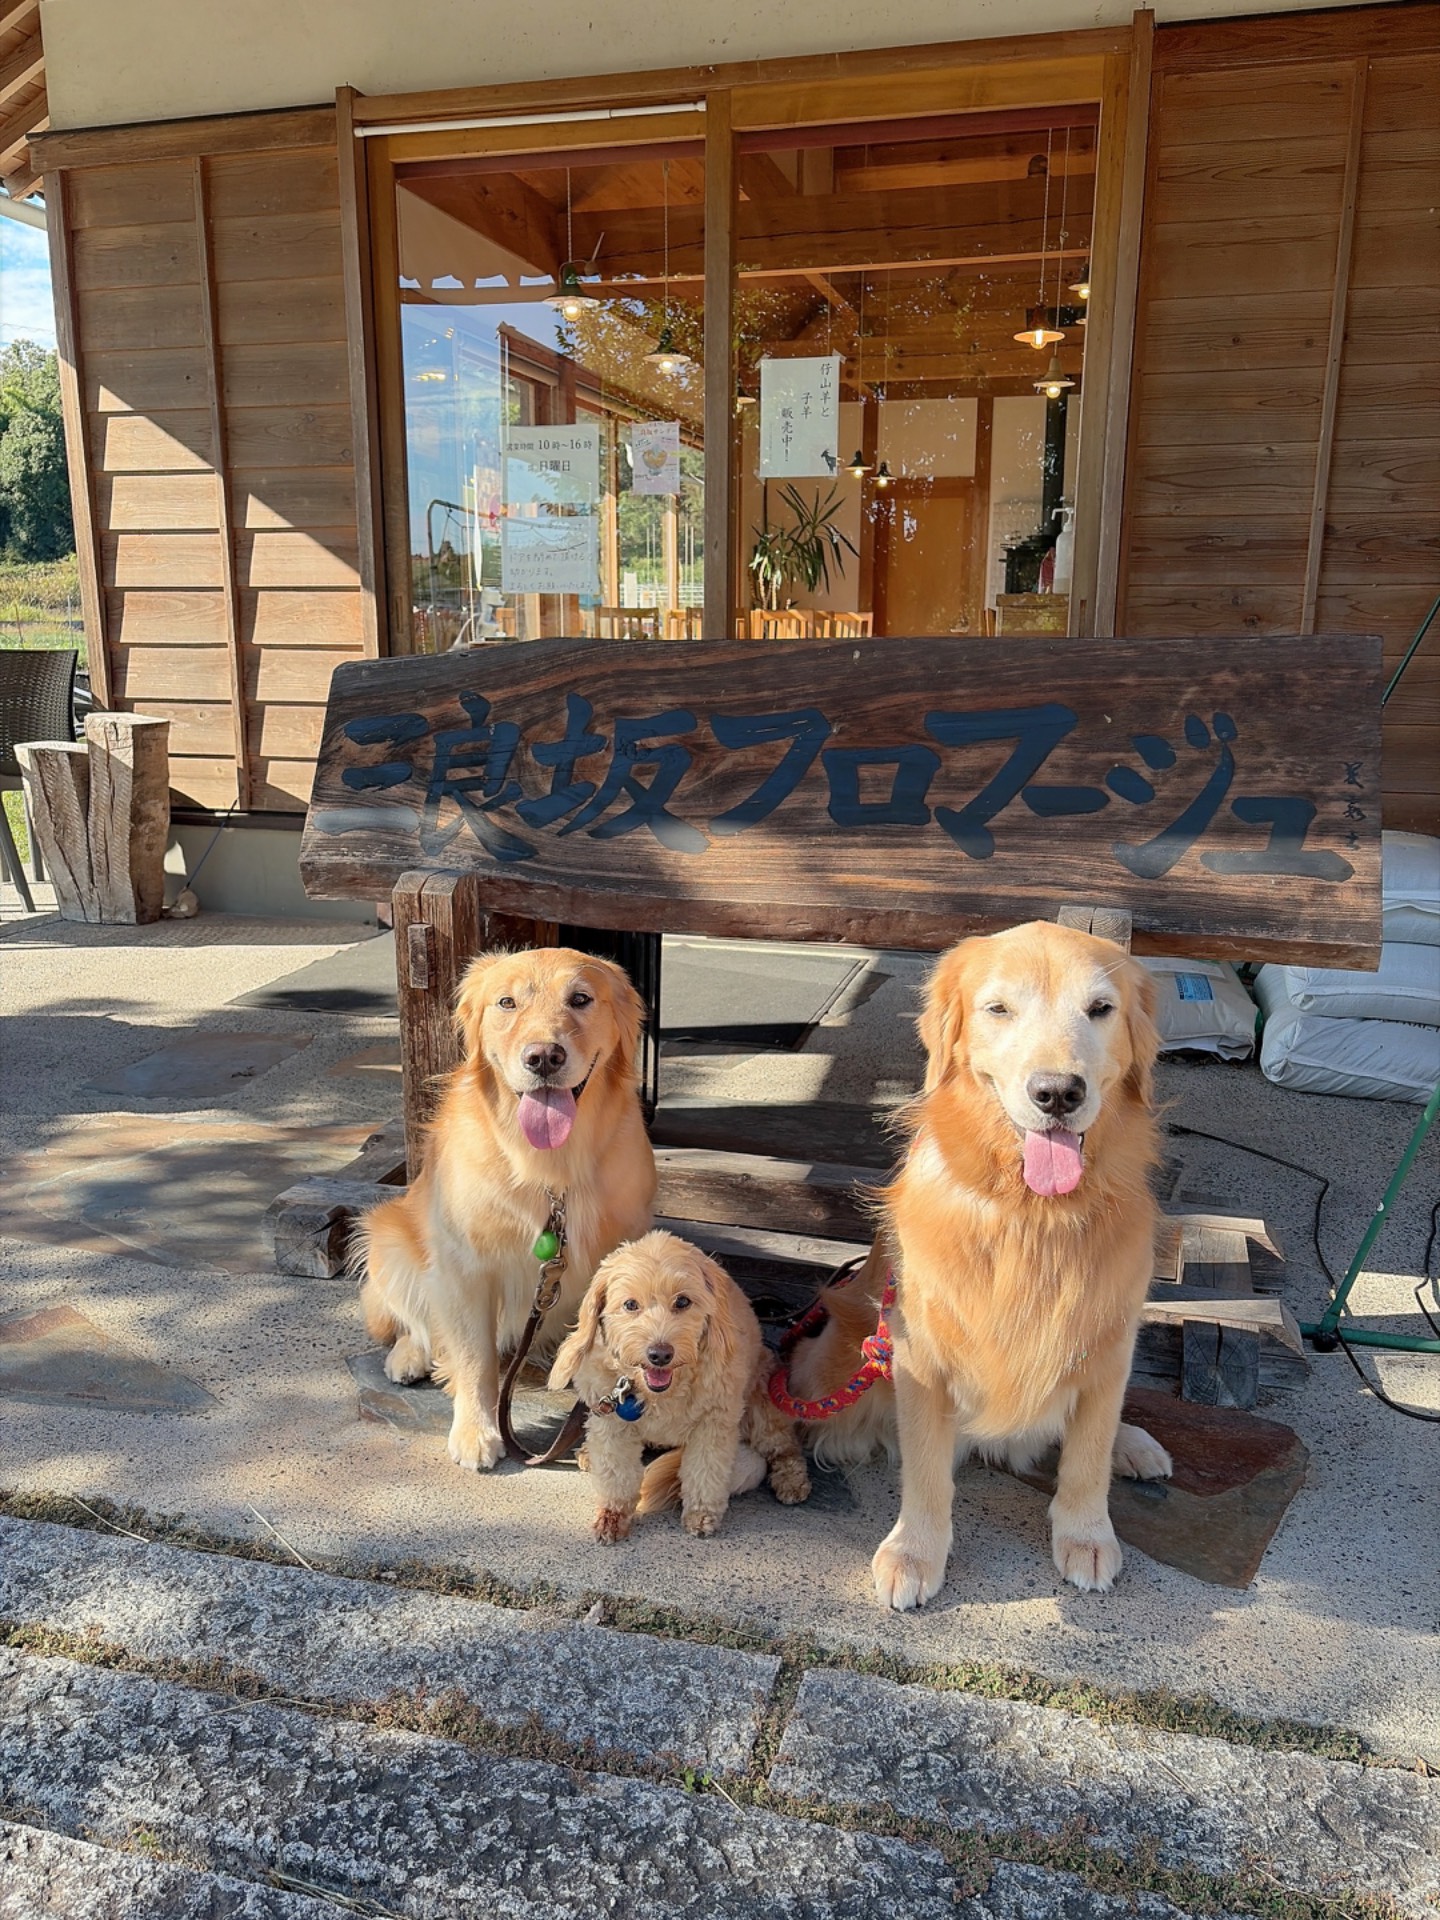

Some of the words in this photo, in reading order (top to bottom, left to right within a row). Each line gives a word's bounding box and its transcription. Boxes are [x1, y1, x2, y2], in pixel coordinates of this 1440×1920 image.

[800, 391, 813, 420] 子羊
[819, 362, 833, 418] 仔山羊と
[312, 690, 1355, 881] 三良坂フロマージュ
